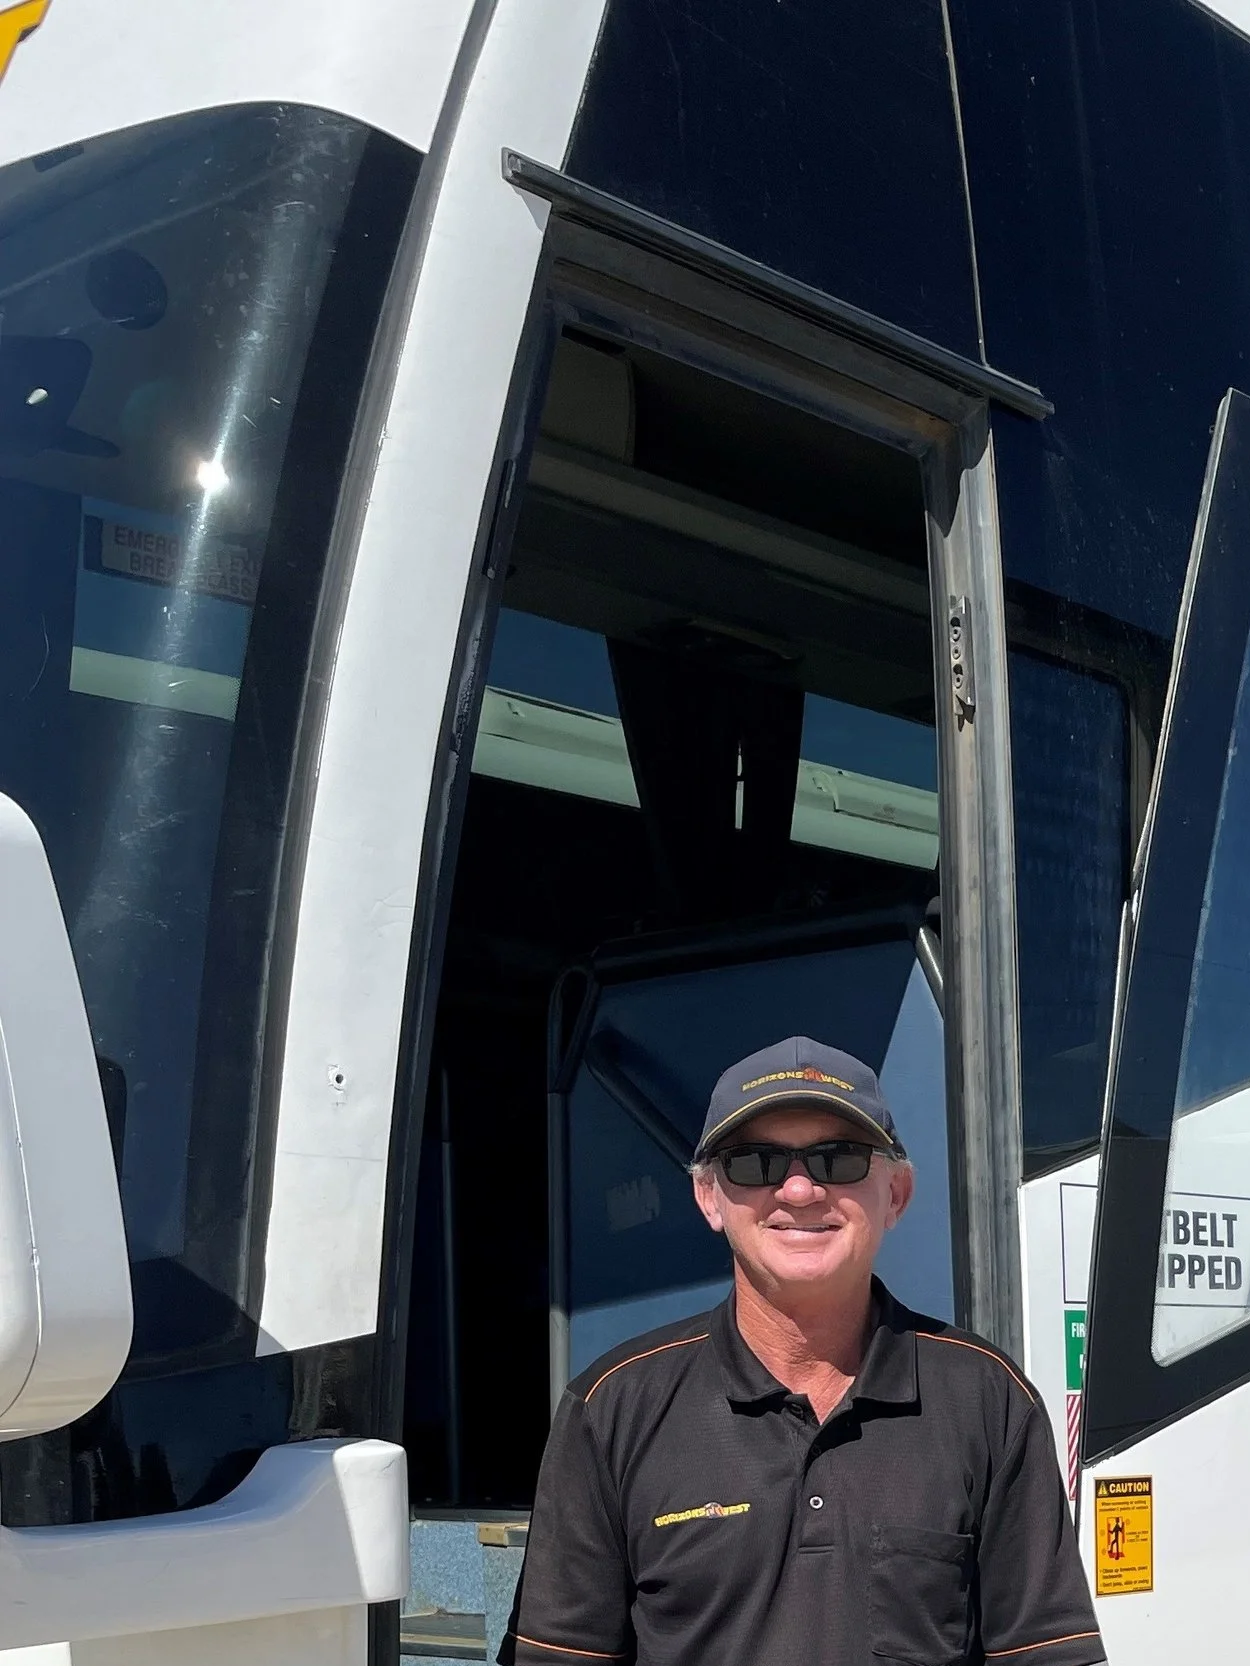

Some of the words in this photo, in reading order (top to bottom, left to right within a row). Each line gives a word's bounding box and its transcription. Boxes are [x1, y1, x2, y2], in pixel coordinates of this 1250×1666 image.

[742, 1071, 804, 1092] HORIZONS
[820, 1073, 855, 1092] WEST
[1109, 1481, 1150, 1494] CAUTION
